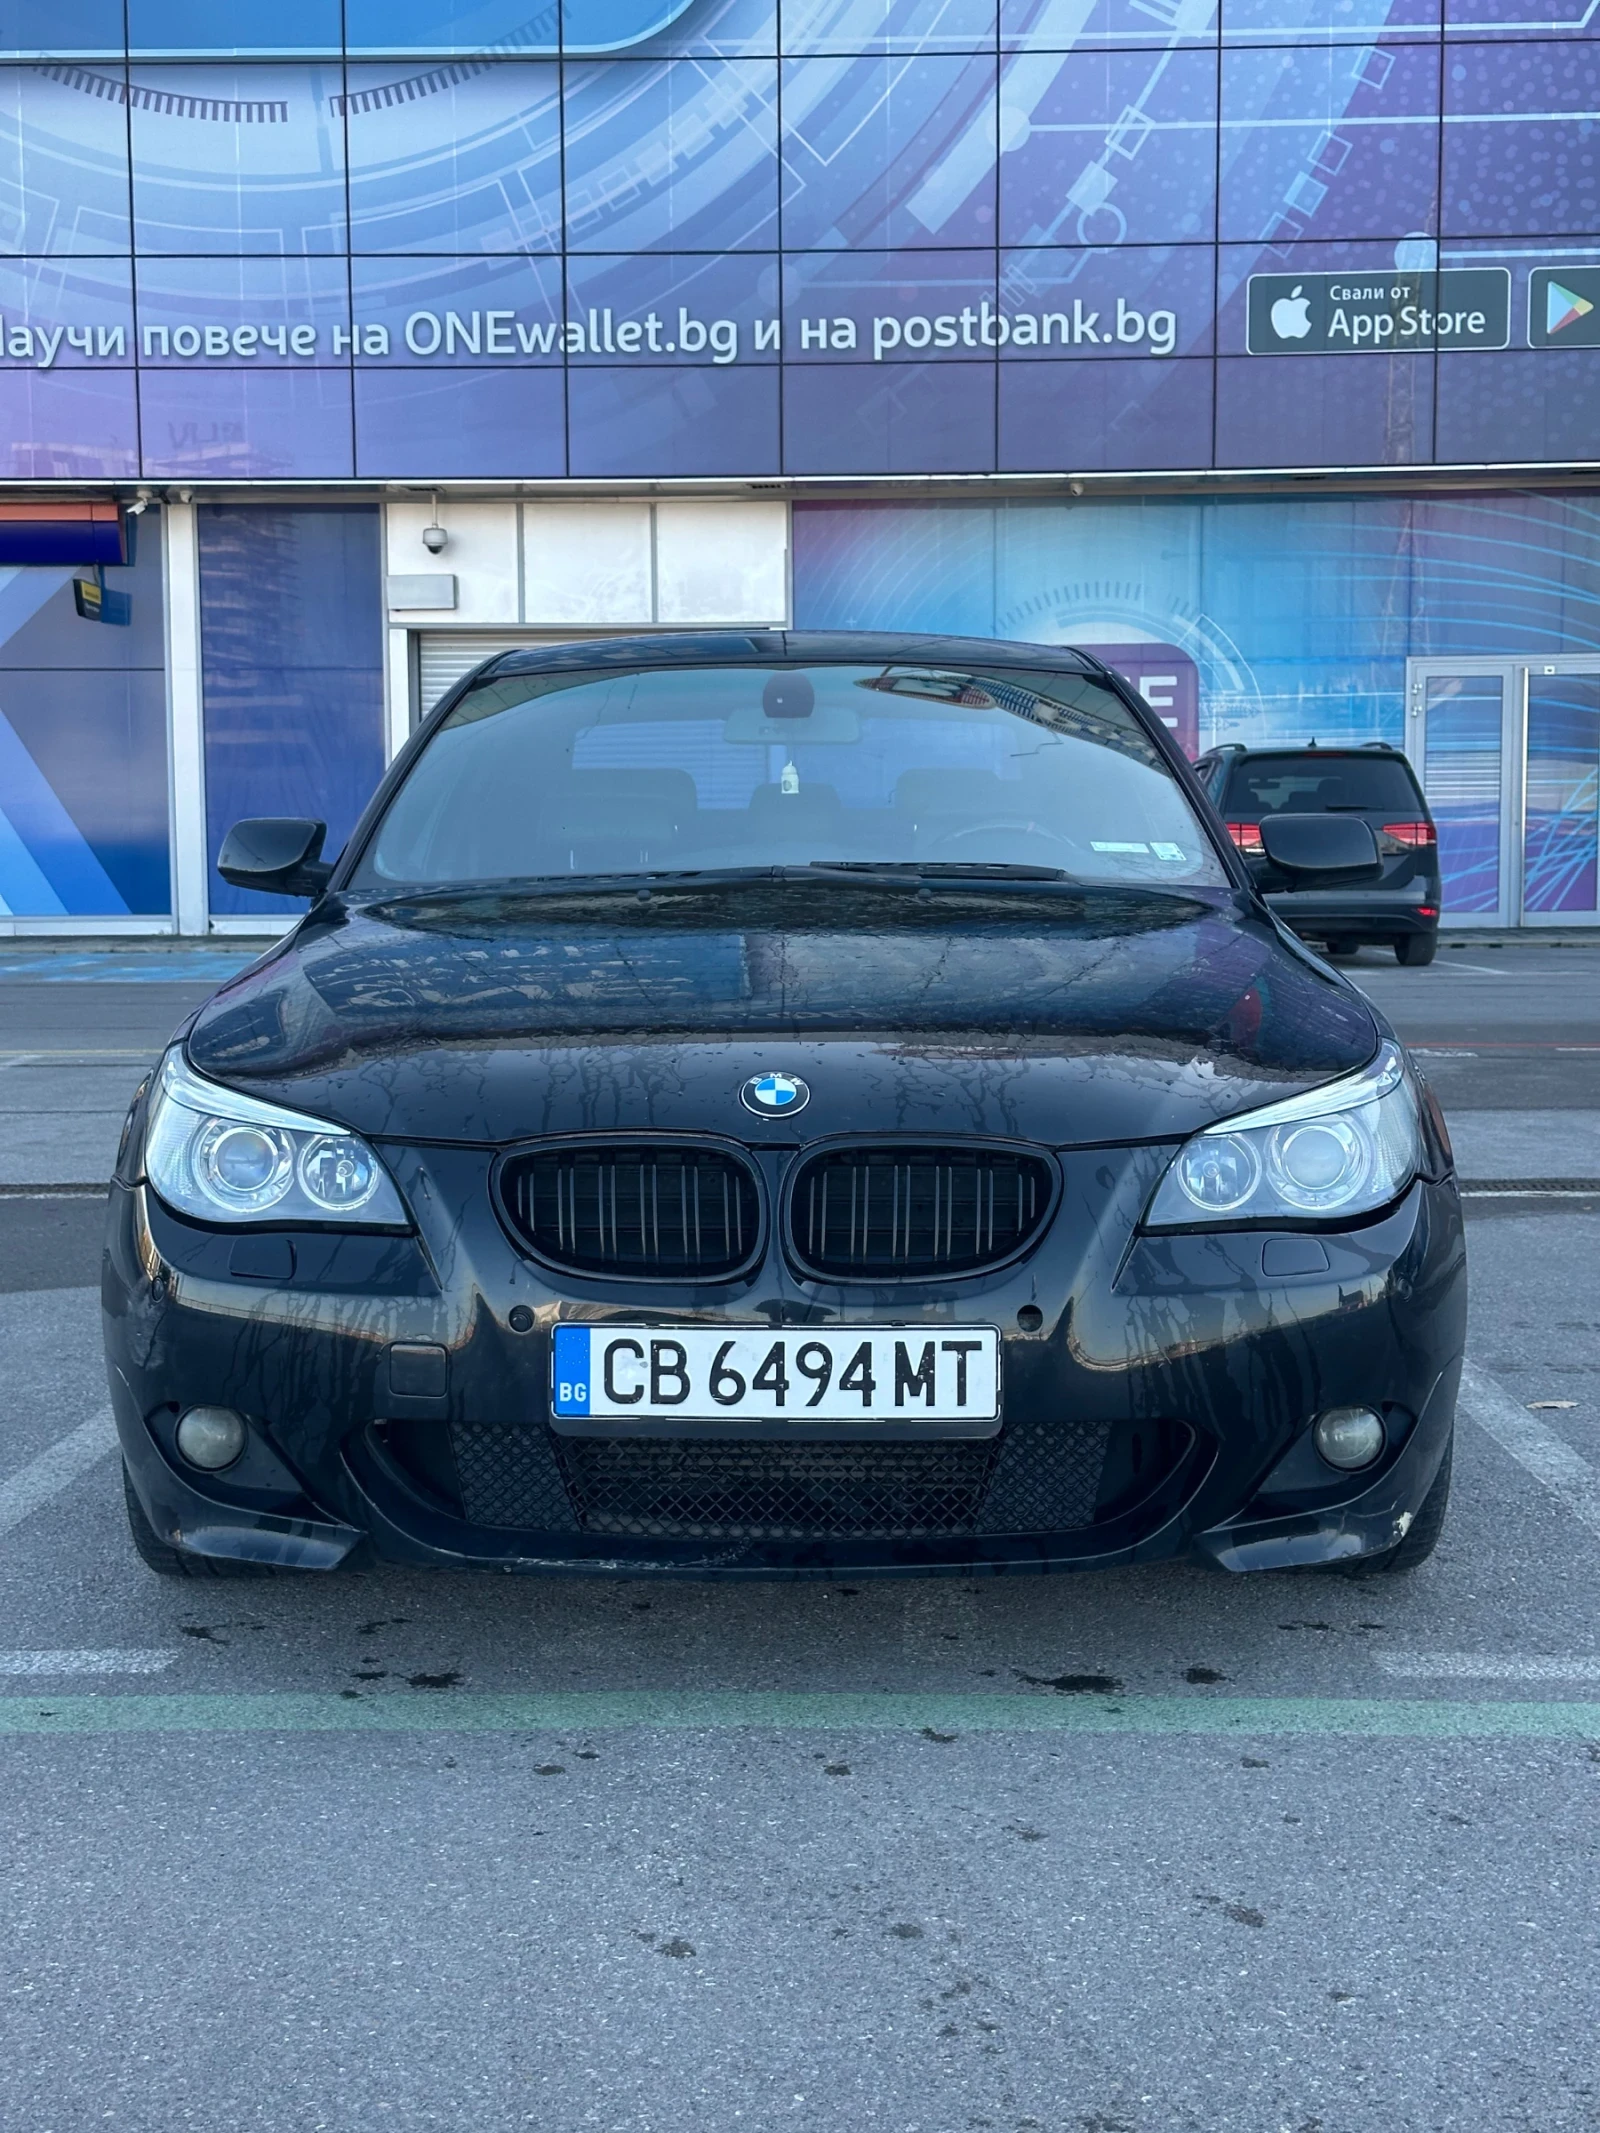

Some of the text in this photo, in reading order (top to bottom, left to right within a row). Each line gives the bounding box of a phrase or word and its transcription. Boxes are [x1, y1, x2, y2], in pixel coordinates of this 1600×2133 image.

[1330, 285, 1411, 301] Свали от
[143, 324, 316, 356] повече
[332, 323, 389, 355] на
[405, 307, 738, 364] ONEwallet.bg
[754, 319, 781, 351] и
[801, 316, 857, 349] на
[873, 298, 1176, 360] postbank.bg
[1328, 306, 1486, 344] App Store
[1123, 675, 1178, 728] E
[749, 1073, 804, 1086] BMW
[603, 1338, 983, 1407] CB 6494 MT
[559, 1382, 587, 1402] BG
